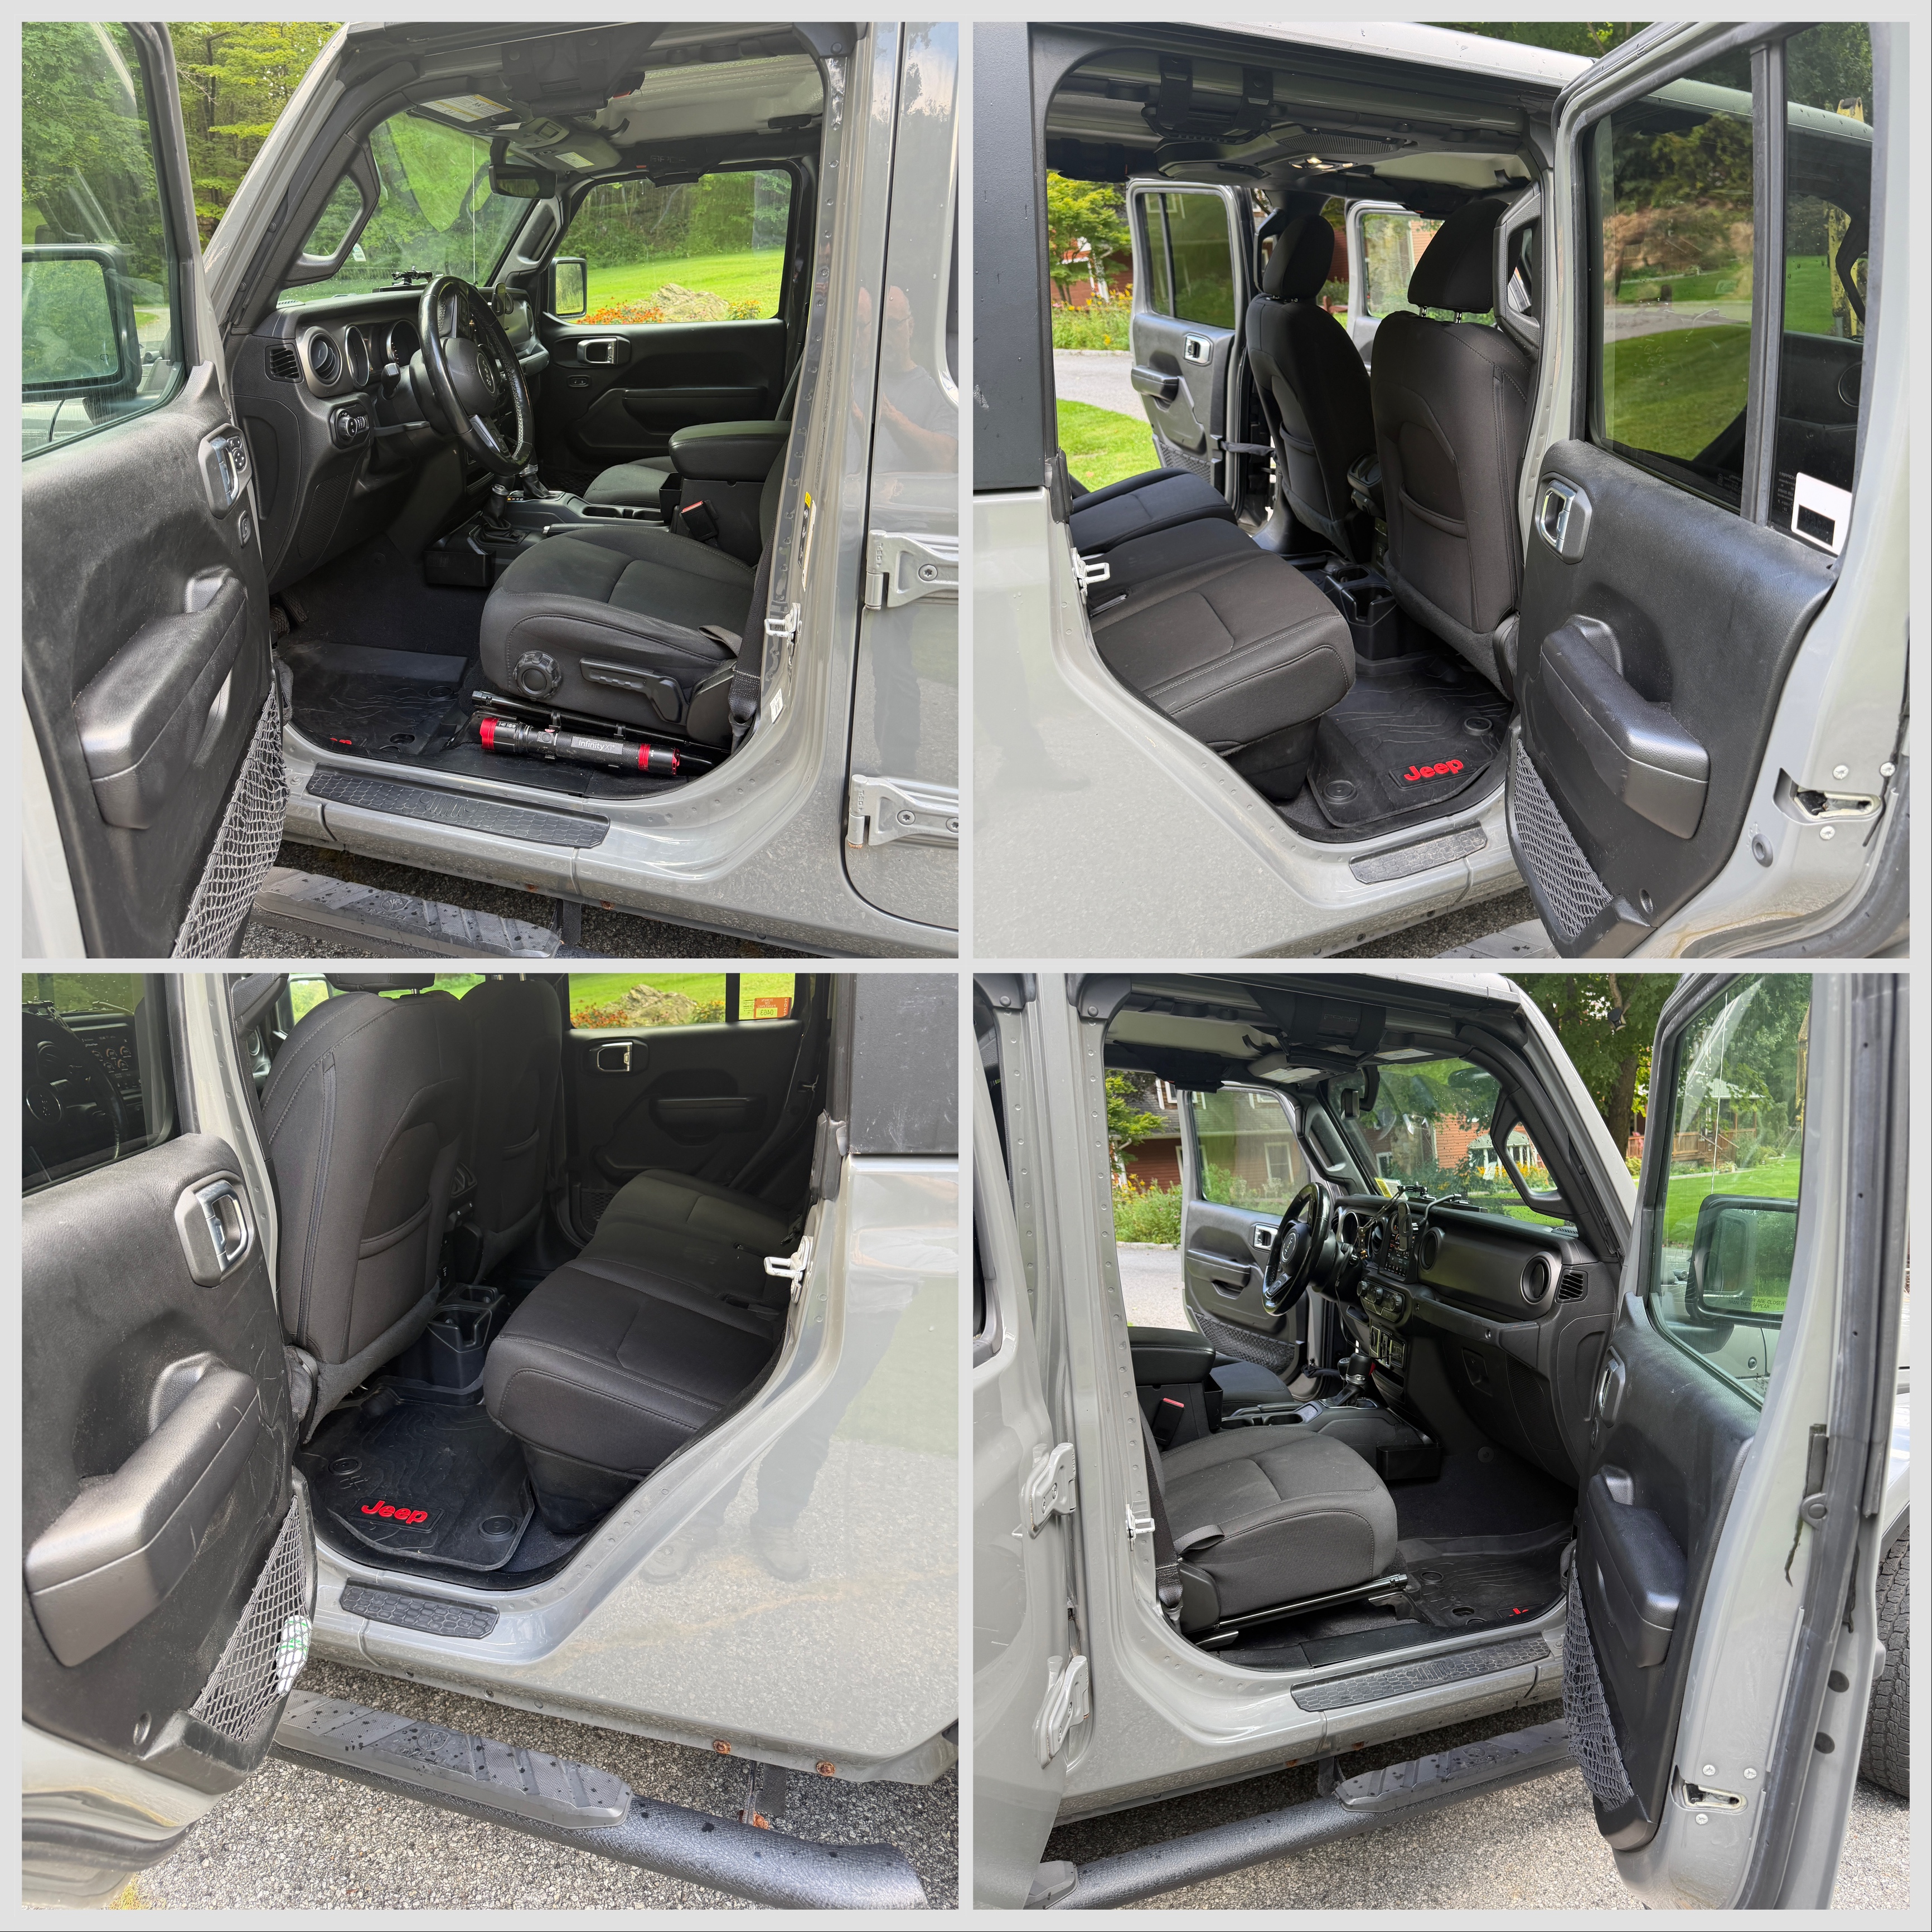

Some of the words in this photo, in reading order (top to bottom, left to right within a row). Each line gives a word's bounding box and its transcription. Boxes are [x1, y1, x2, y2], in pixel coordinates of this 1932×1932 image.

[578, 739, 605, 751] Infinity
[1403, 759, 1464, 781] Jeep
[361, 1500, 428, 1524] Jeep
